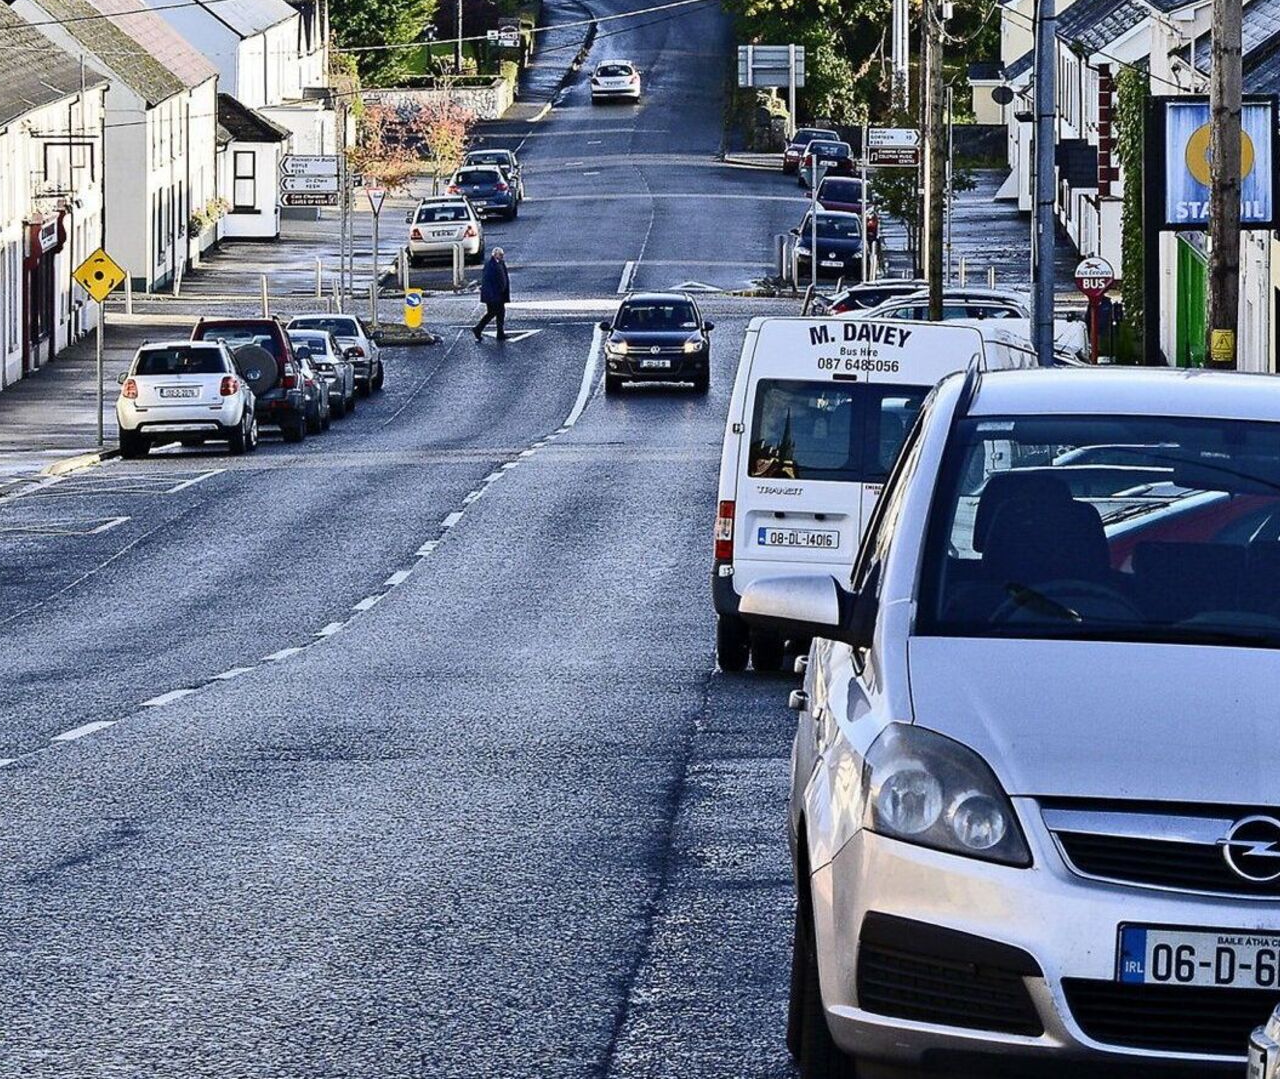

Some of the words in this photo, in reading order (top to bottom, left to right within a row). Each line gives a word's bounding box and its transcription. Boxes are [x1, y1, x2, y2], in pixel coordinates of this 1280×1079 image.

[1176, 201, 1265, 219] STAIL
[1083, 279, 1105, 289] BUS
[809, 325, 835, 345] M.
[843, 323, 912, 348] DAVEY
[840, 347, 857, 356] Bus
[860, 348, 878, 357] Hire
[817, 357, 840, 370] 087
[845, 358, 899, 372] 6485056
[770, 532, 832, 546] 08-DL-14016
[1218, 936, 1243, 946] BAILE
[1125, 961, 1144, 973] IRL
